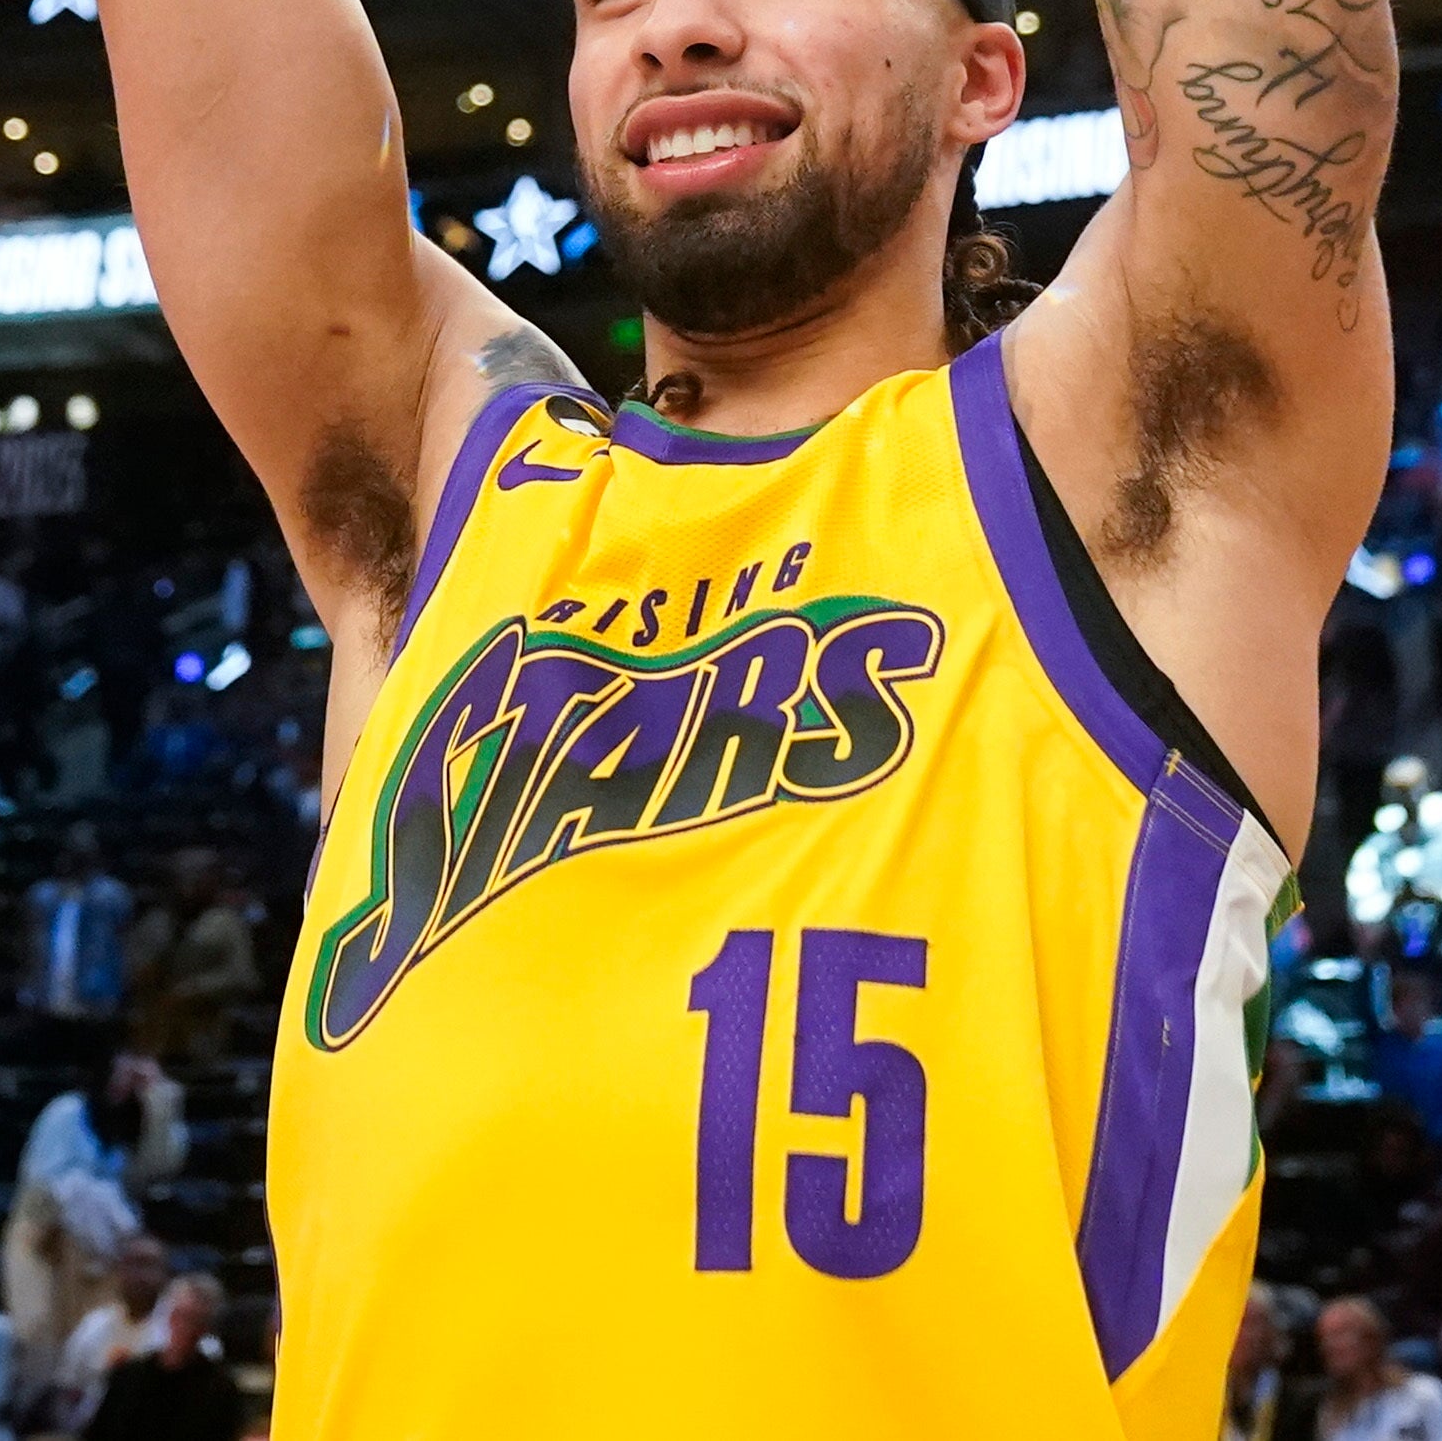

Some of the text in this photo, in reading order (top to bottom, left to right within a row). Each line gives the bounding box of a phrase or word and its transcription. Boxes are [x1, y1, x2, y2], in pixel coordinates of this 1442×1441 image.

[534, 541, 813, 648] RISING
[305, 594, 945, 1053] STARS
[686, 927, 929, 1280] 15
